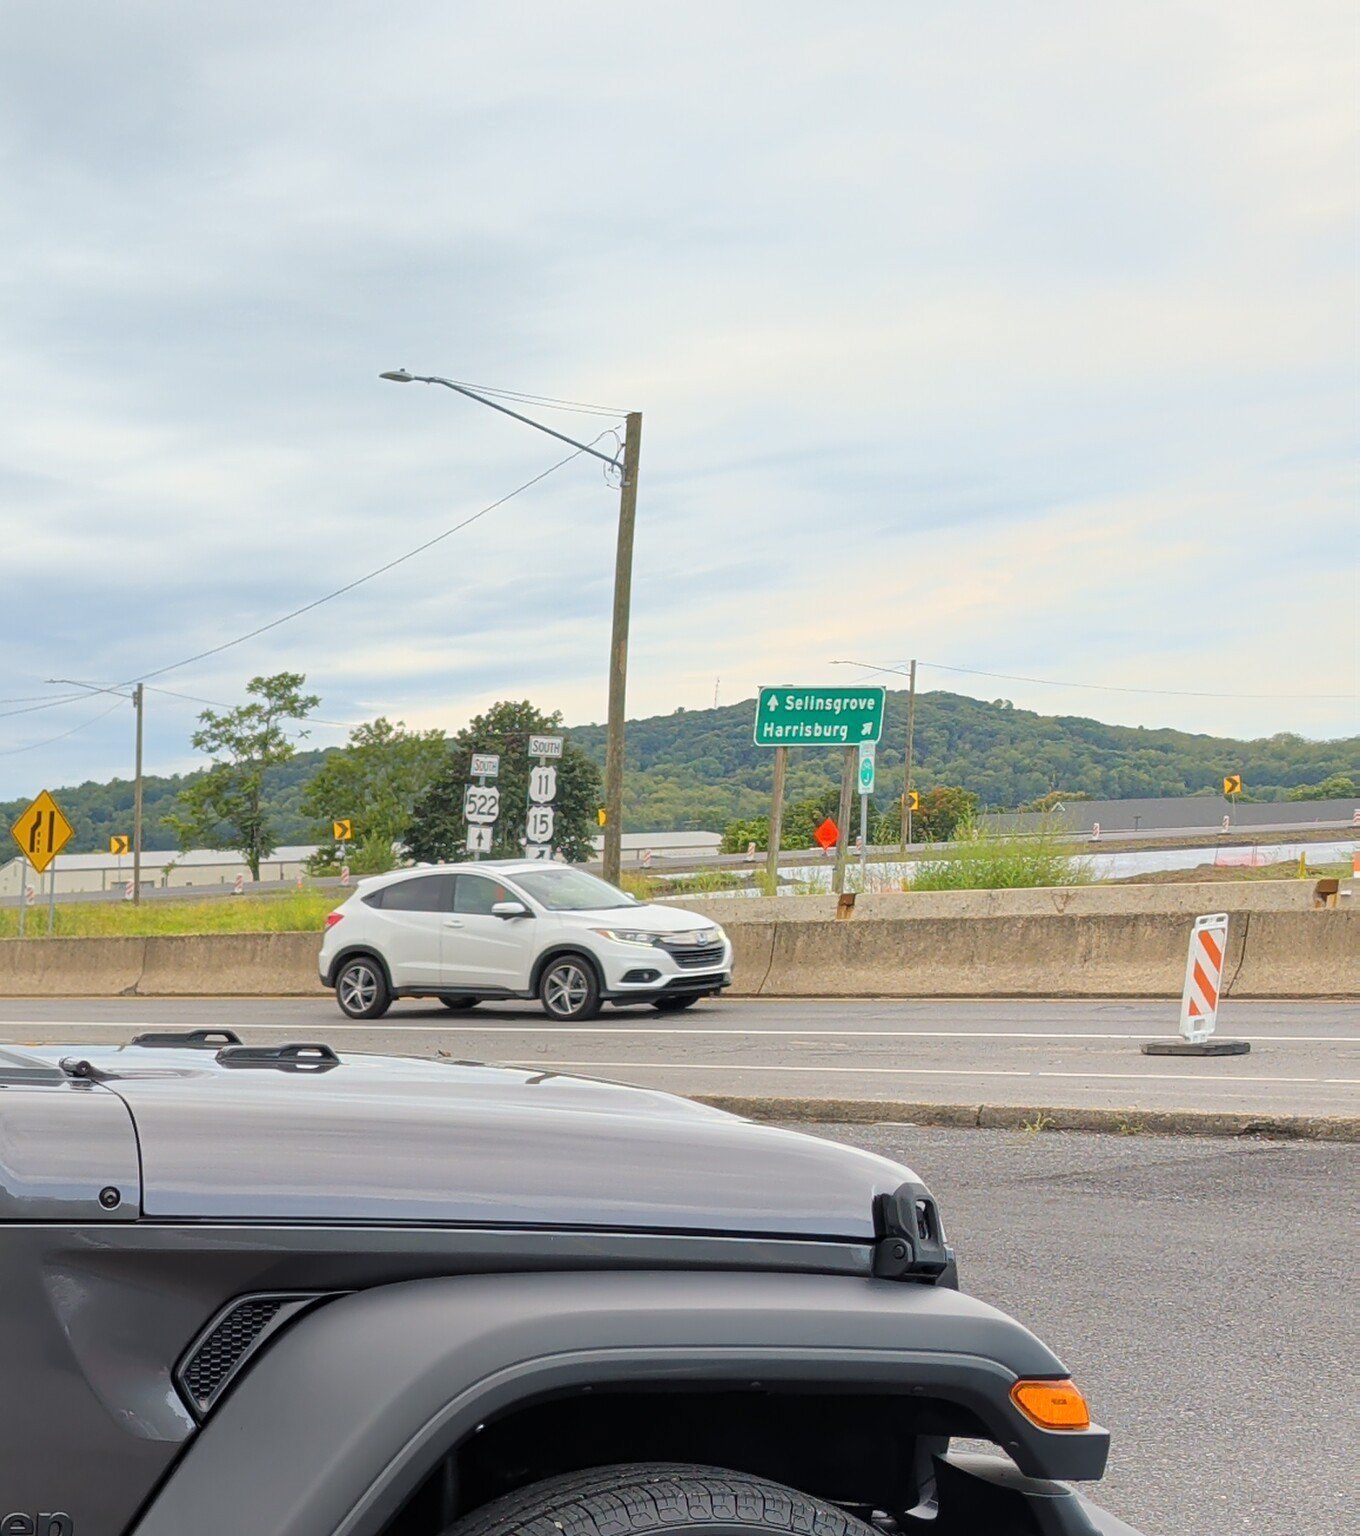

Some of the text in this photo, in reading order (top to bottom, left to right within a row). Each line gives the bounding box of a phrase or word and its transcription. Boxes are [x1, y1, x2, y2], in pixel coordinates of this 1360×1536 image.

[784, 695, 876, 715] Selinsgrove
[762, 722, 849, 741] Harrisburg
[532, 740, 560, 754] SOUTH
[538, 774, 549, 795] 11
[467, 794, 497, 816] 522
[533, 814, 549, 835] 15
